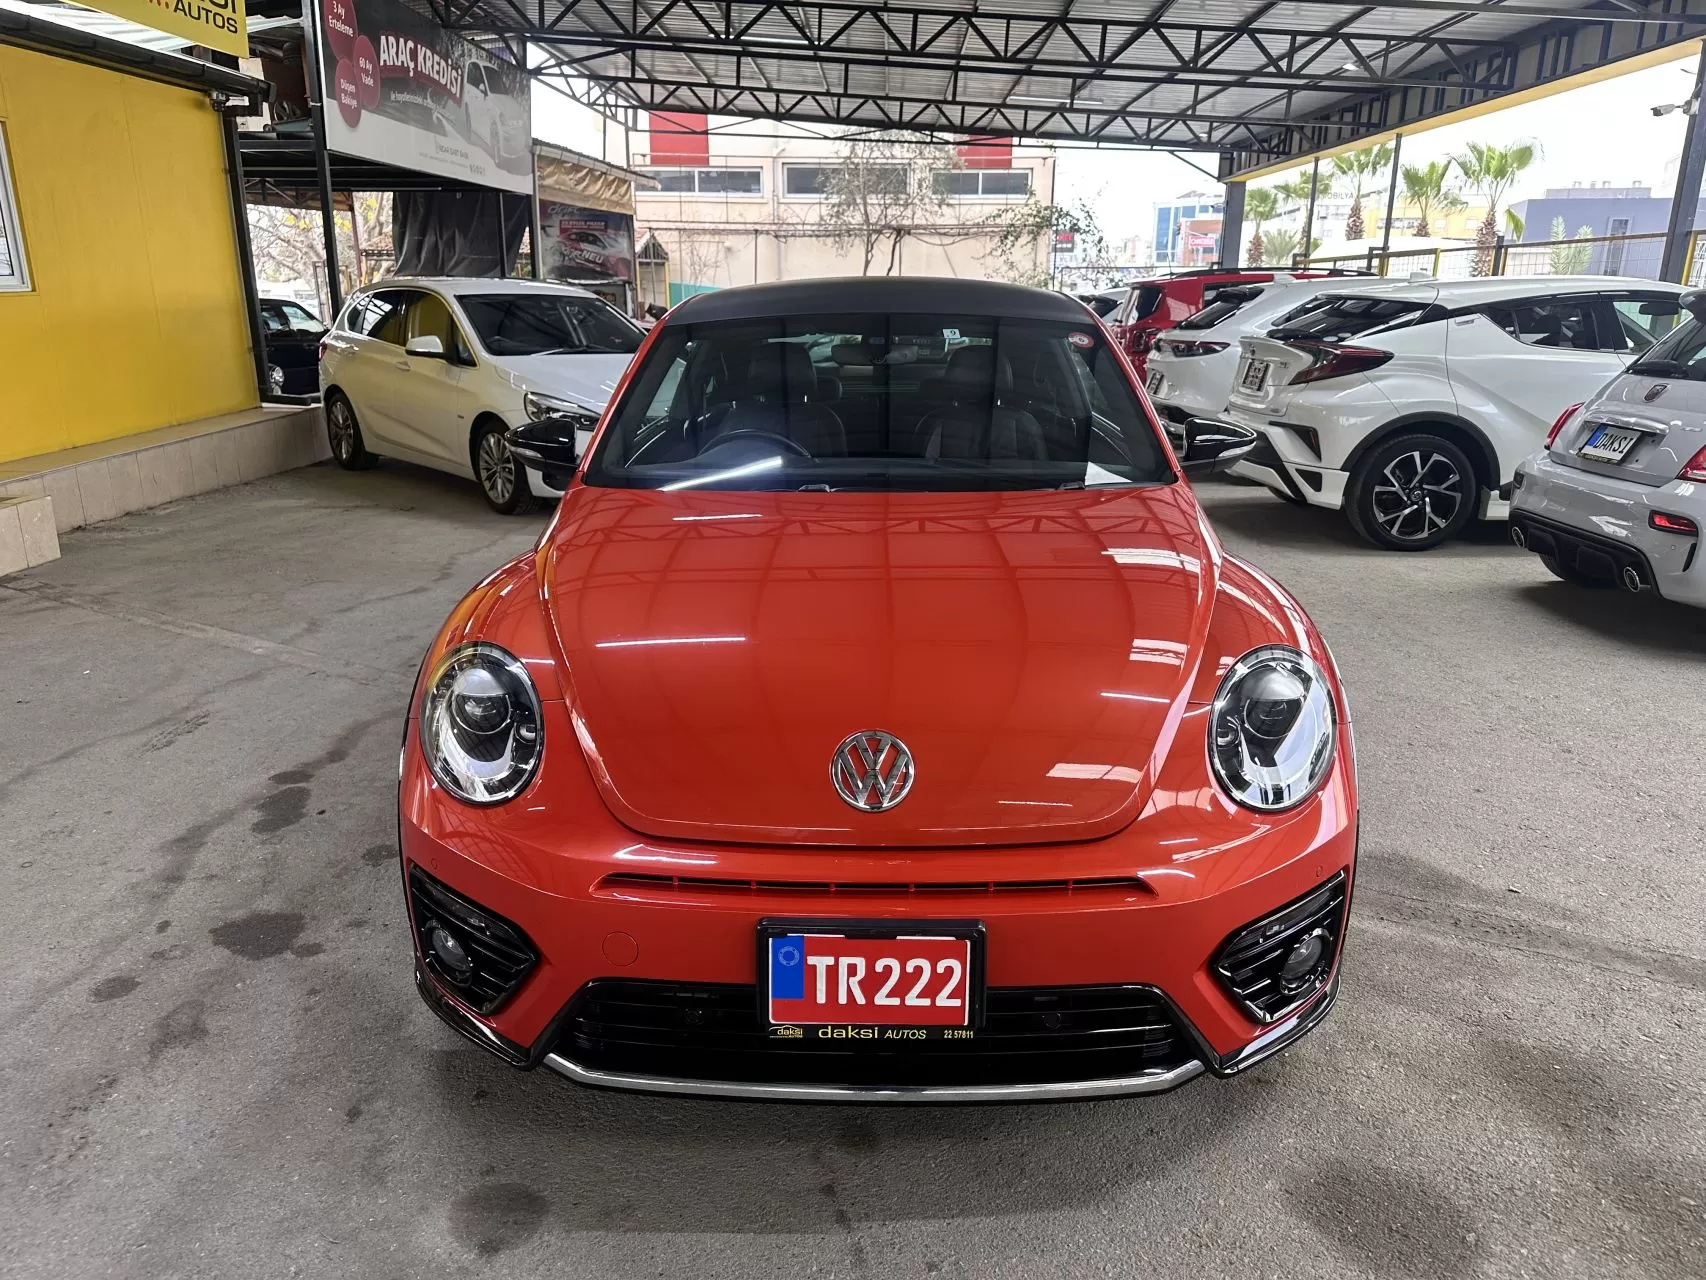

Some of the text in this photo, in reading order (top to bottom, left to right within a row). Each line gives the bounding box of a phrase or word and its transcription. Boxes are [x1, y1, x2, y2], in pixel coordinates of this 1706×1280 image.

[173, 0, 238, 34] AUTOS
[333, 0, 345, 19] 3 Ay
[328, 15, 354, 37] Erteleme
[380, 35, 462, 98] ARAÇ KREDİSİ
[1593, 432, 1634, 454] DAKSI
[818, 1025, 879, 1039] daksi
[884, 1029, 927, 1040] AUTOS
